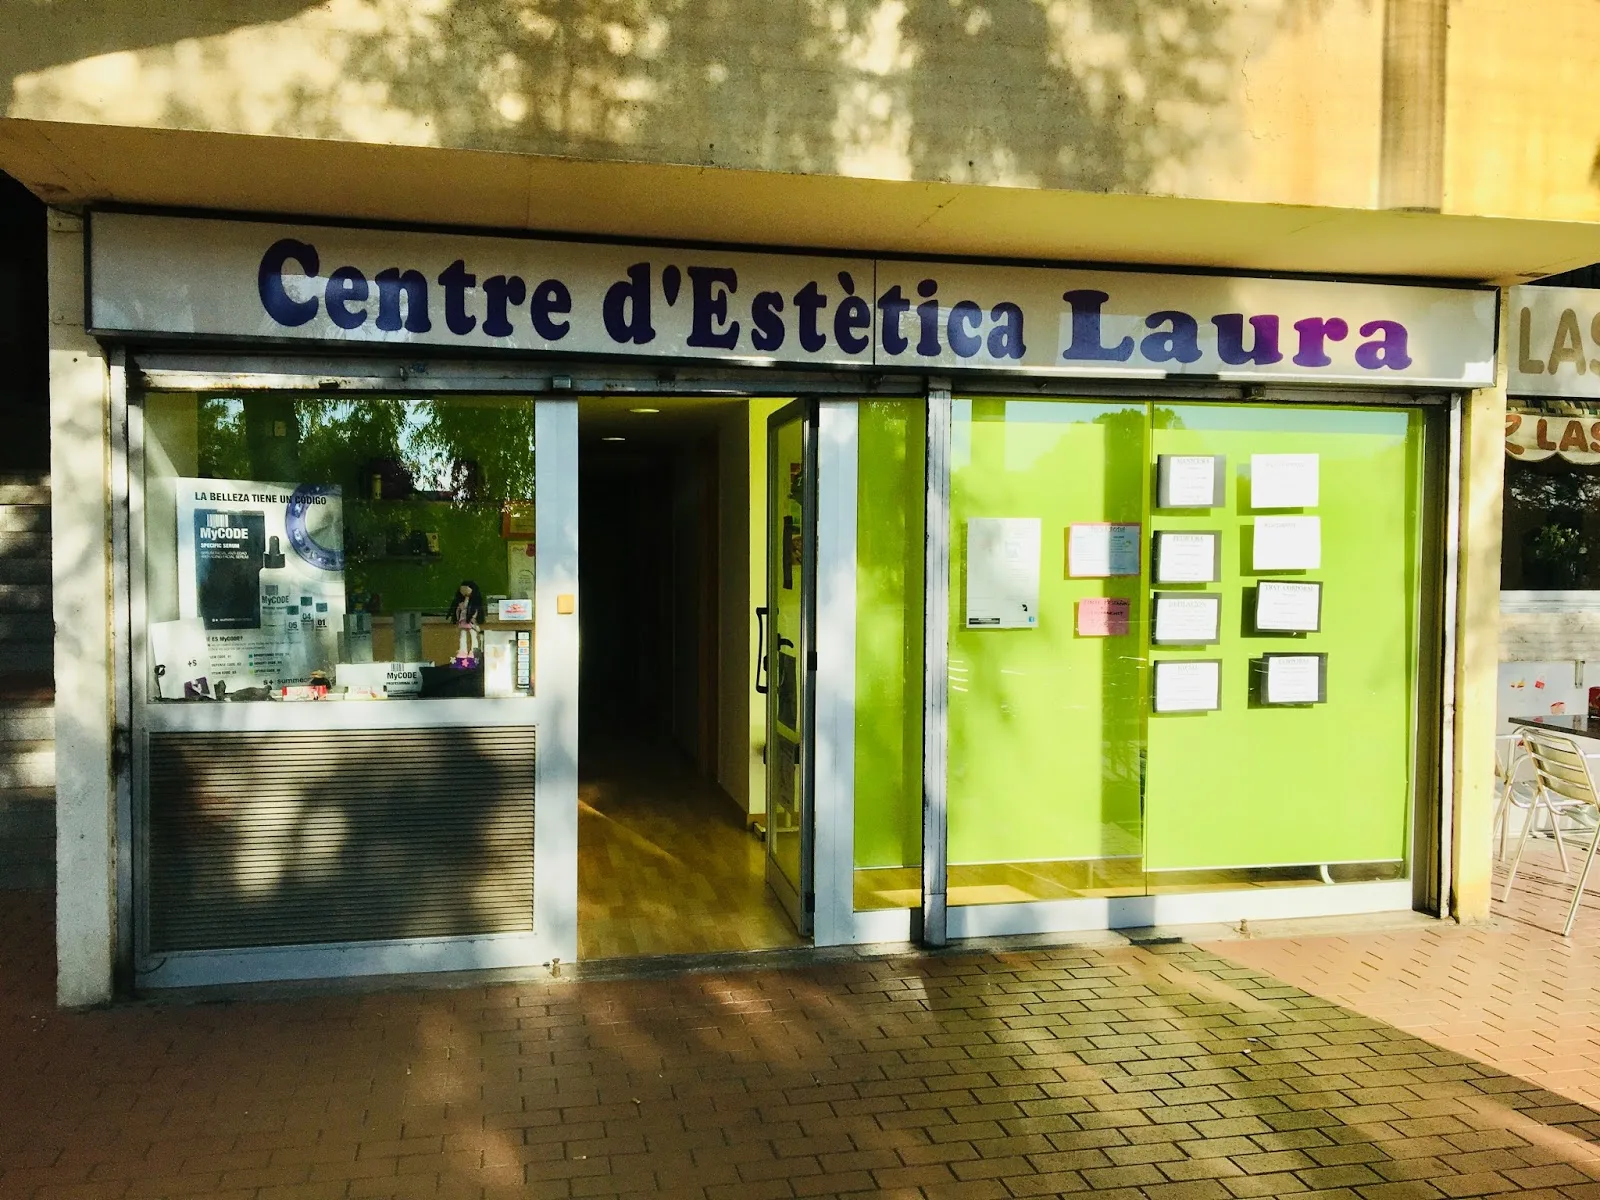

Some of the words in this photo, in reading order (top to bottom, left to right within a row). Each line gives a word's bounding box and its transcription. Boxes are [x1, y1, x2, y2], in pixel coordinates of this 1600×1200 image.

[258, 239, 572, 341] Centre
[603, 262, 1026, 360] d'Estètica
[1062, 289, 1412, 371] Laura
[194, 491, 206, 501] LA
[210, 492, 250, 502] BELLEZA
[252, 493, 277, 503] TIENE
[280, 494, 292, 503] UN
[200, 527, 249, 541] MyCODE
[261, 595, 290, 605] MyCODE
[386, 671, 417, 680] MyCODE
